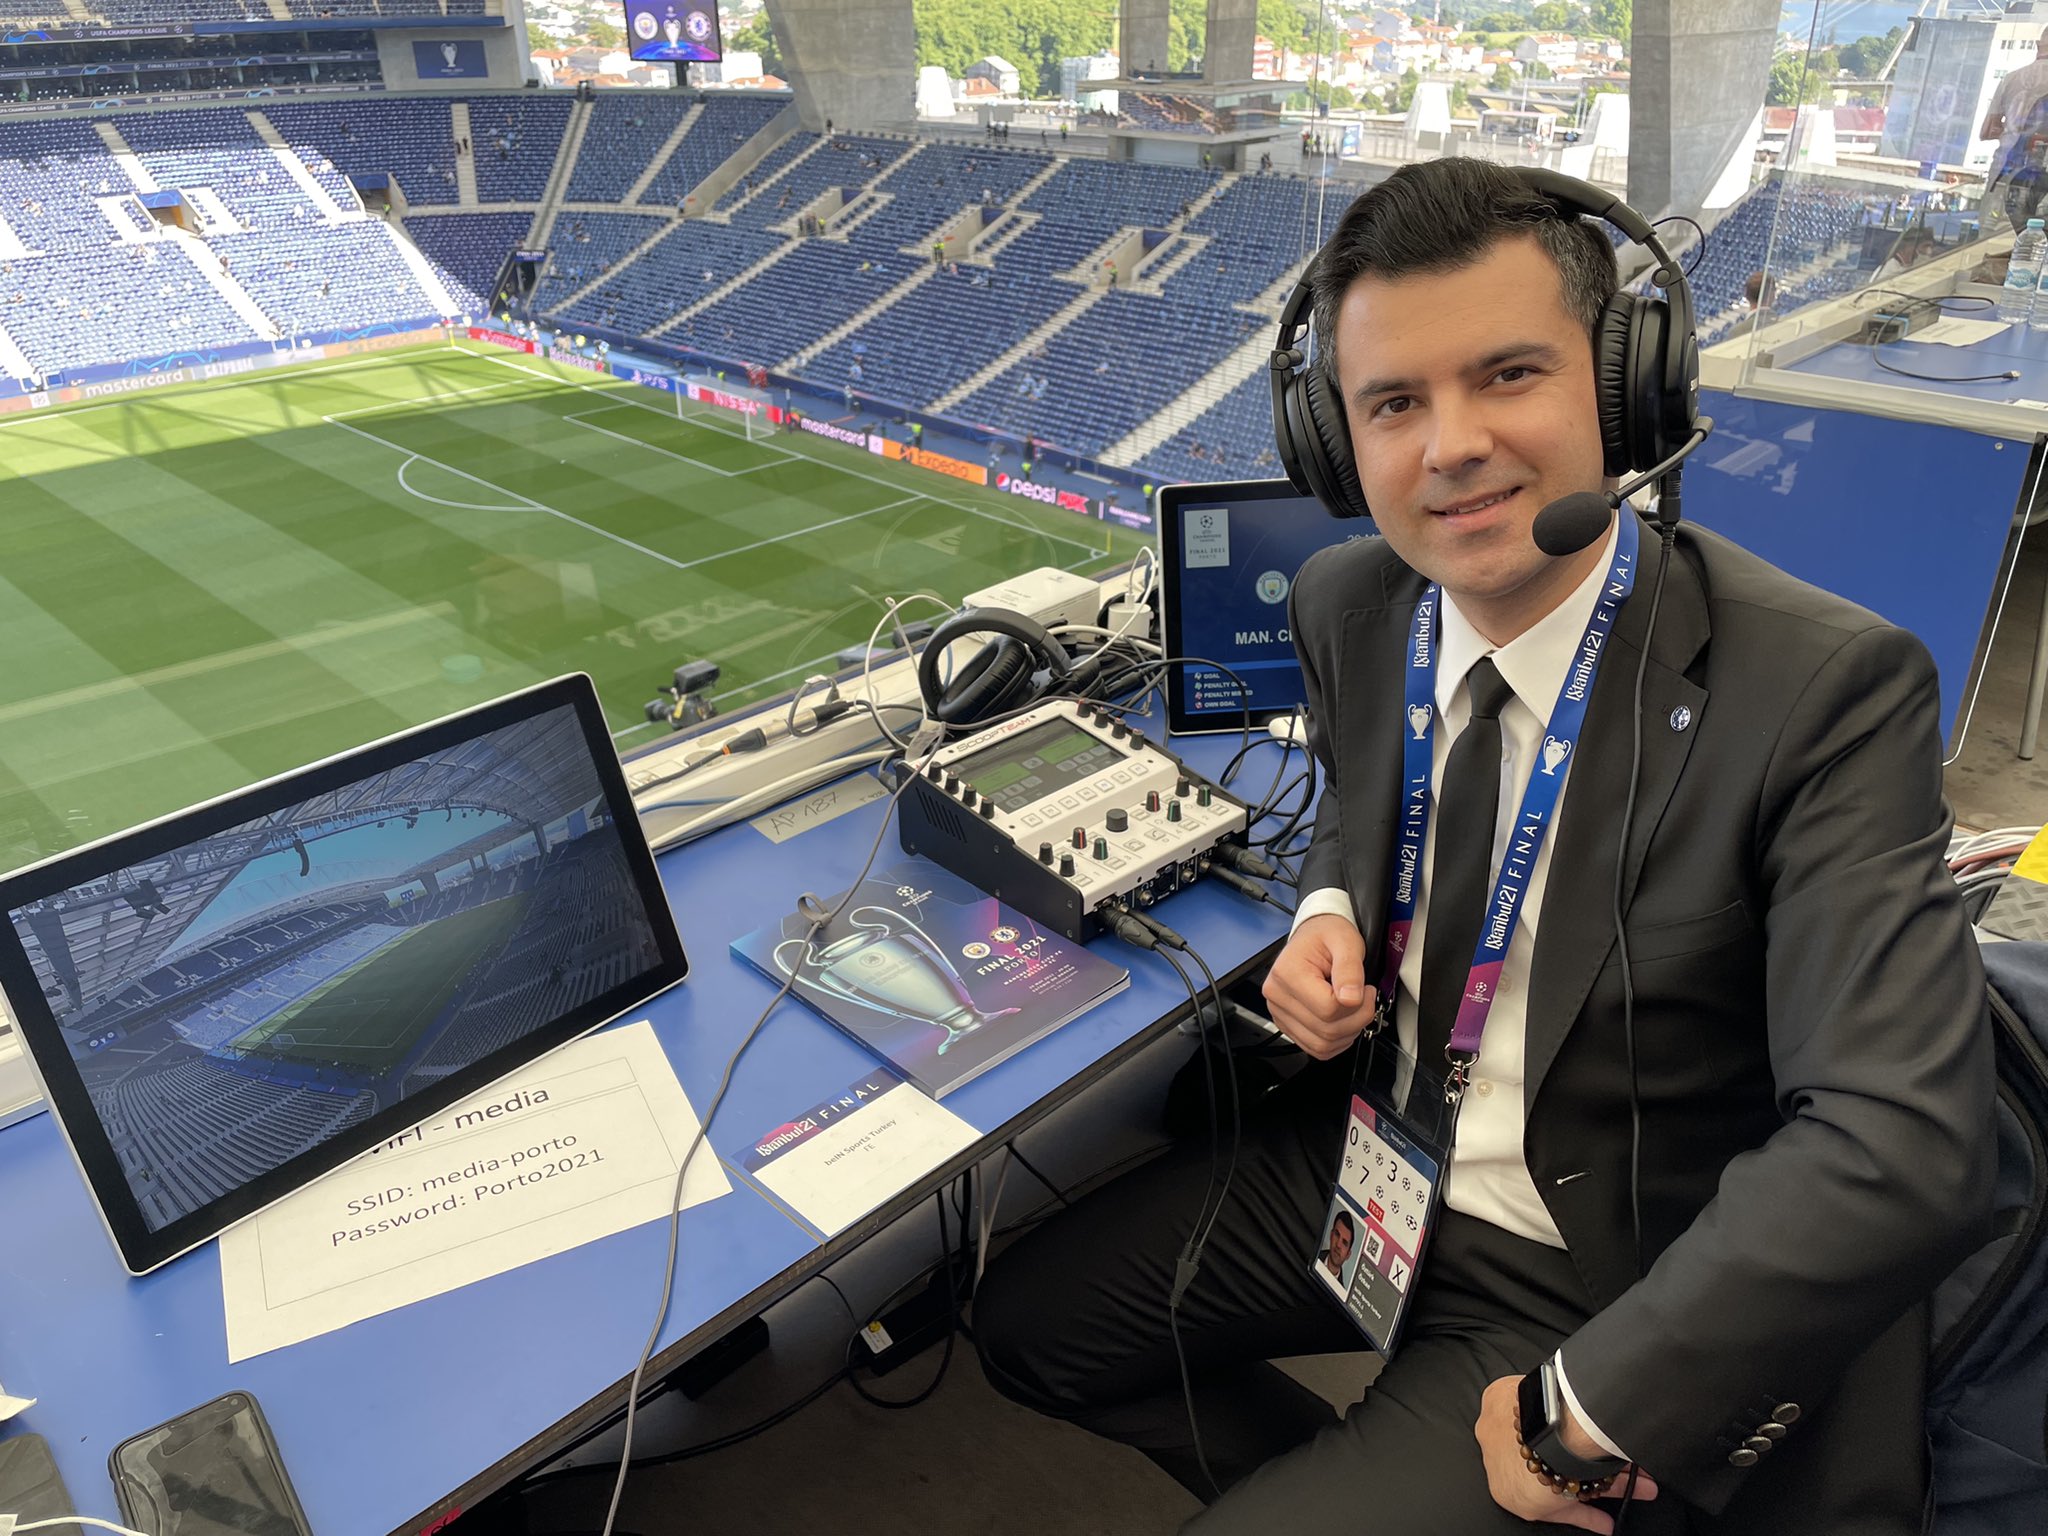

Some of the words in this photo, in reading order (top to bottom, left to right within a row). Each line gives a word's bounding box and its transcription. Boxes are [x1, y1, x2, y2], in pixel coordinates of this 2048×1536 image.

[85, 369, 184, 399] mastercard
[713, 391, 761, 416] NISSA
[800, 417, 866, 447] mastercard
[918, 453, 969, 479] Expedia
[1010, 478, 1056, 504] pepsi
[1597, 553, 1631, 623] FINAL
[1235, 630, 1274, 645] MAN.
[1203, 681, 1230, 689] PENALTY
[1204, 690, 1230, 698] PENALTY
[1405, 774, 1426, 838] FINAL
[770, 811, 795, 835] AP
[1507, 811, 1543, 879] FINAL
[976, 954, 1015, 976] FINAL
[1014, 935, 1047, 955] 2021
[1003, 949, 1039, 973] PORTO
[454, 1087, 550, 1129] media
[818, 1083, 880, 1120] FINAL
[824, 1150, 846, 1167] beIN
[845, 1135, 871, 1155] Sports
[868, 1118, 898, 1138] Turkey
[863, 1142, 876, 1153] FE
[1349, 1126, 1359, 1146] 0
[347, 1186, 414, 1216] SSID:
[422, 1134, 578, 1193] media-porto
[1359, 1165, 1370, 1185] 7
[1387, 1160, 1398, 1182] 3
[331, 1194, 467, 1247] Password:
[474, 1148, 605, 1201] Porto2021
[1369, 1201, 1383, 1220] TEST
[1392, 1263, 1404, 1286] X
